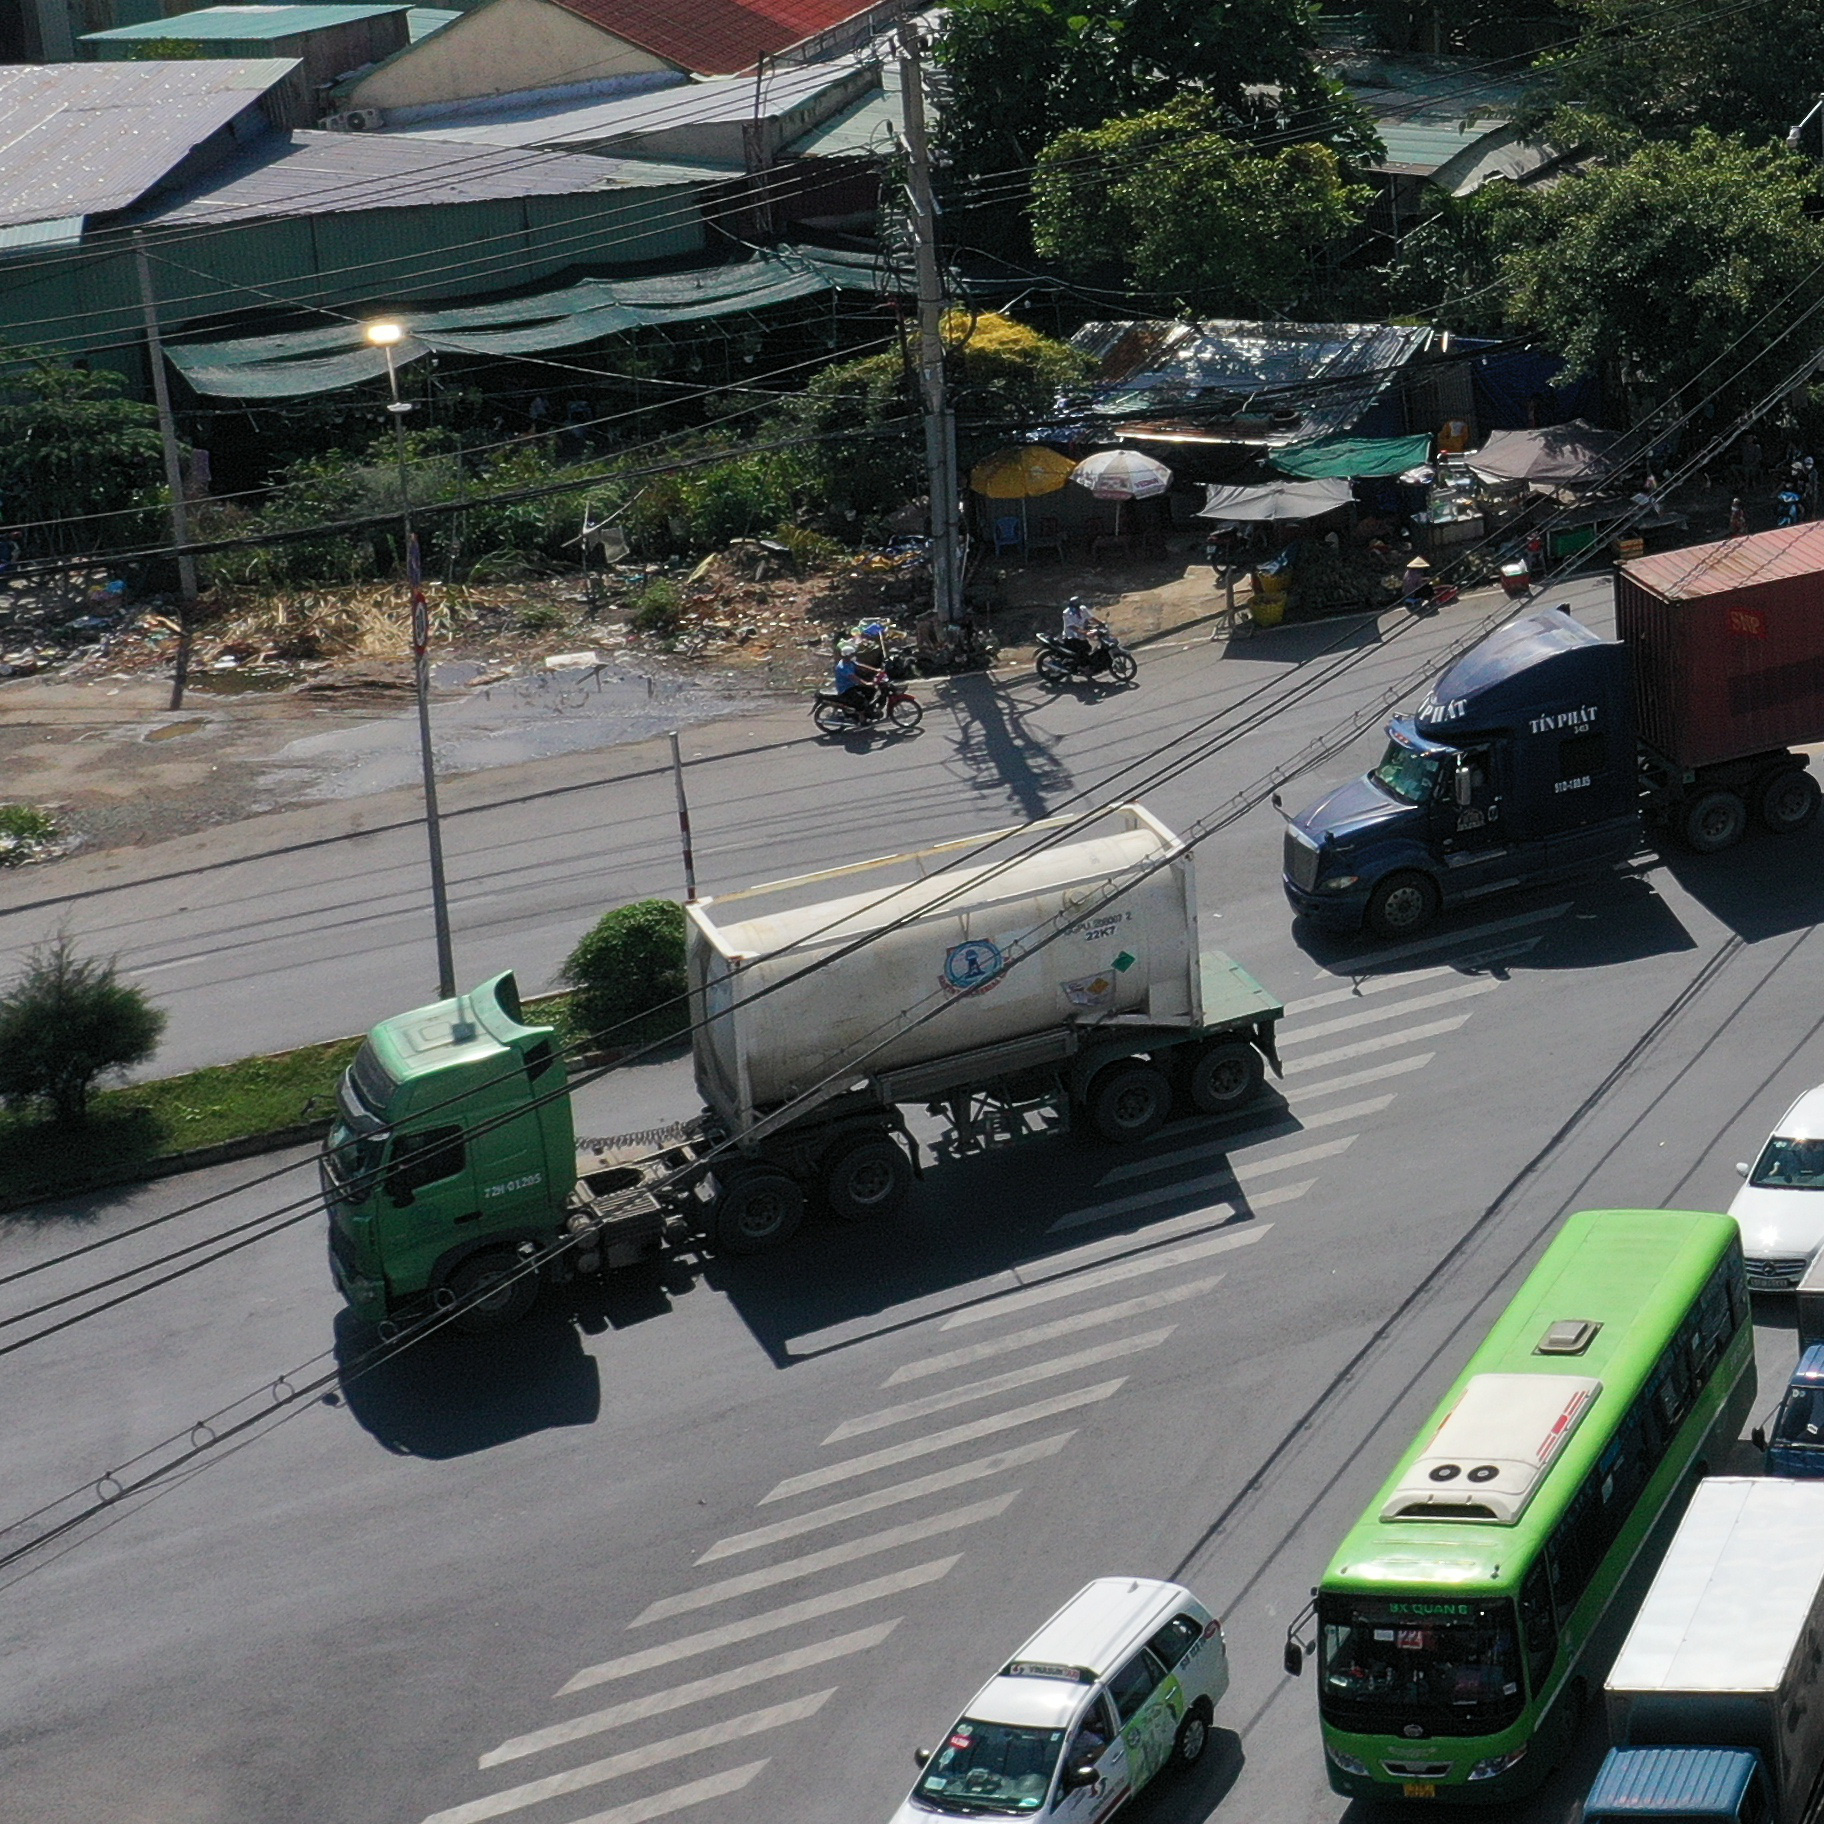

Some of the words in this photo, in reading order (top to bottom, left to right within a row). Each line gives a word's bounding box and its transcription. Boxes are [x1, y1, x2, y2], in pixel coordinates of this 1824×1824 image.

[1529, 713, 1557, 734] TÍN
[1557, 704, 1598, 729] PHÁT
[1085, 925, 1117, 941] 22K7
